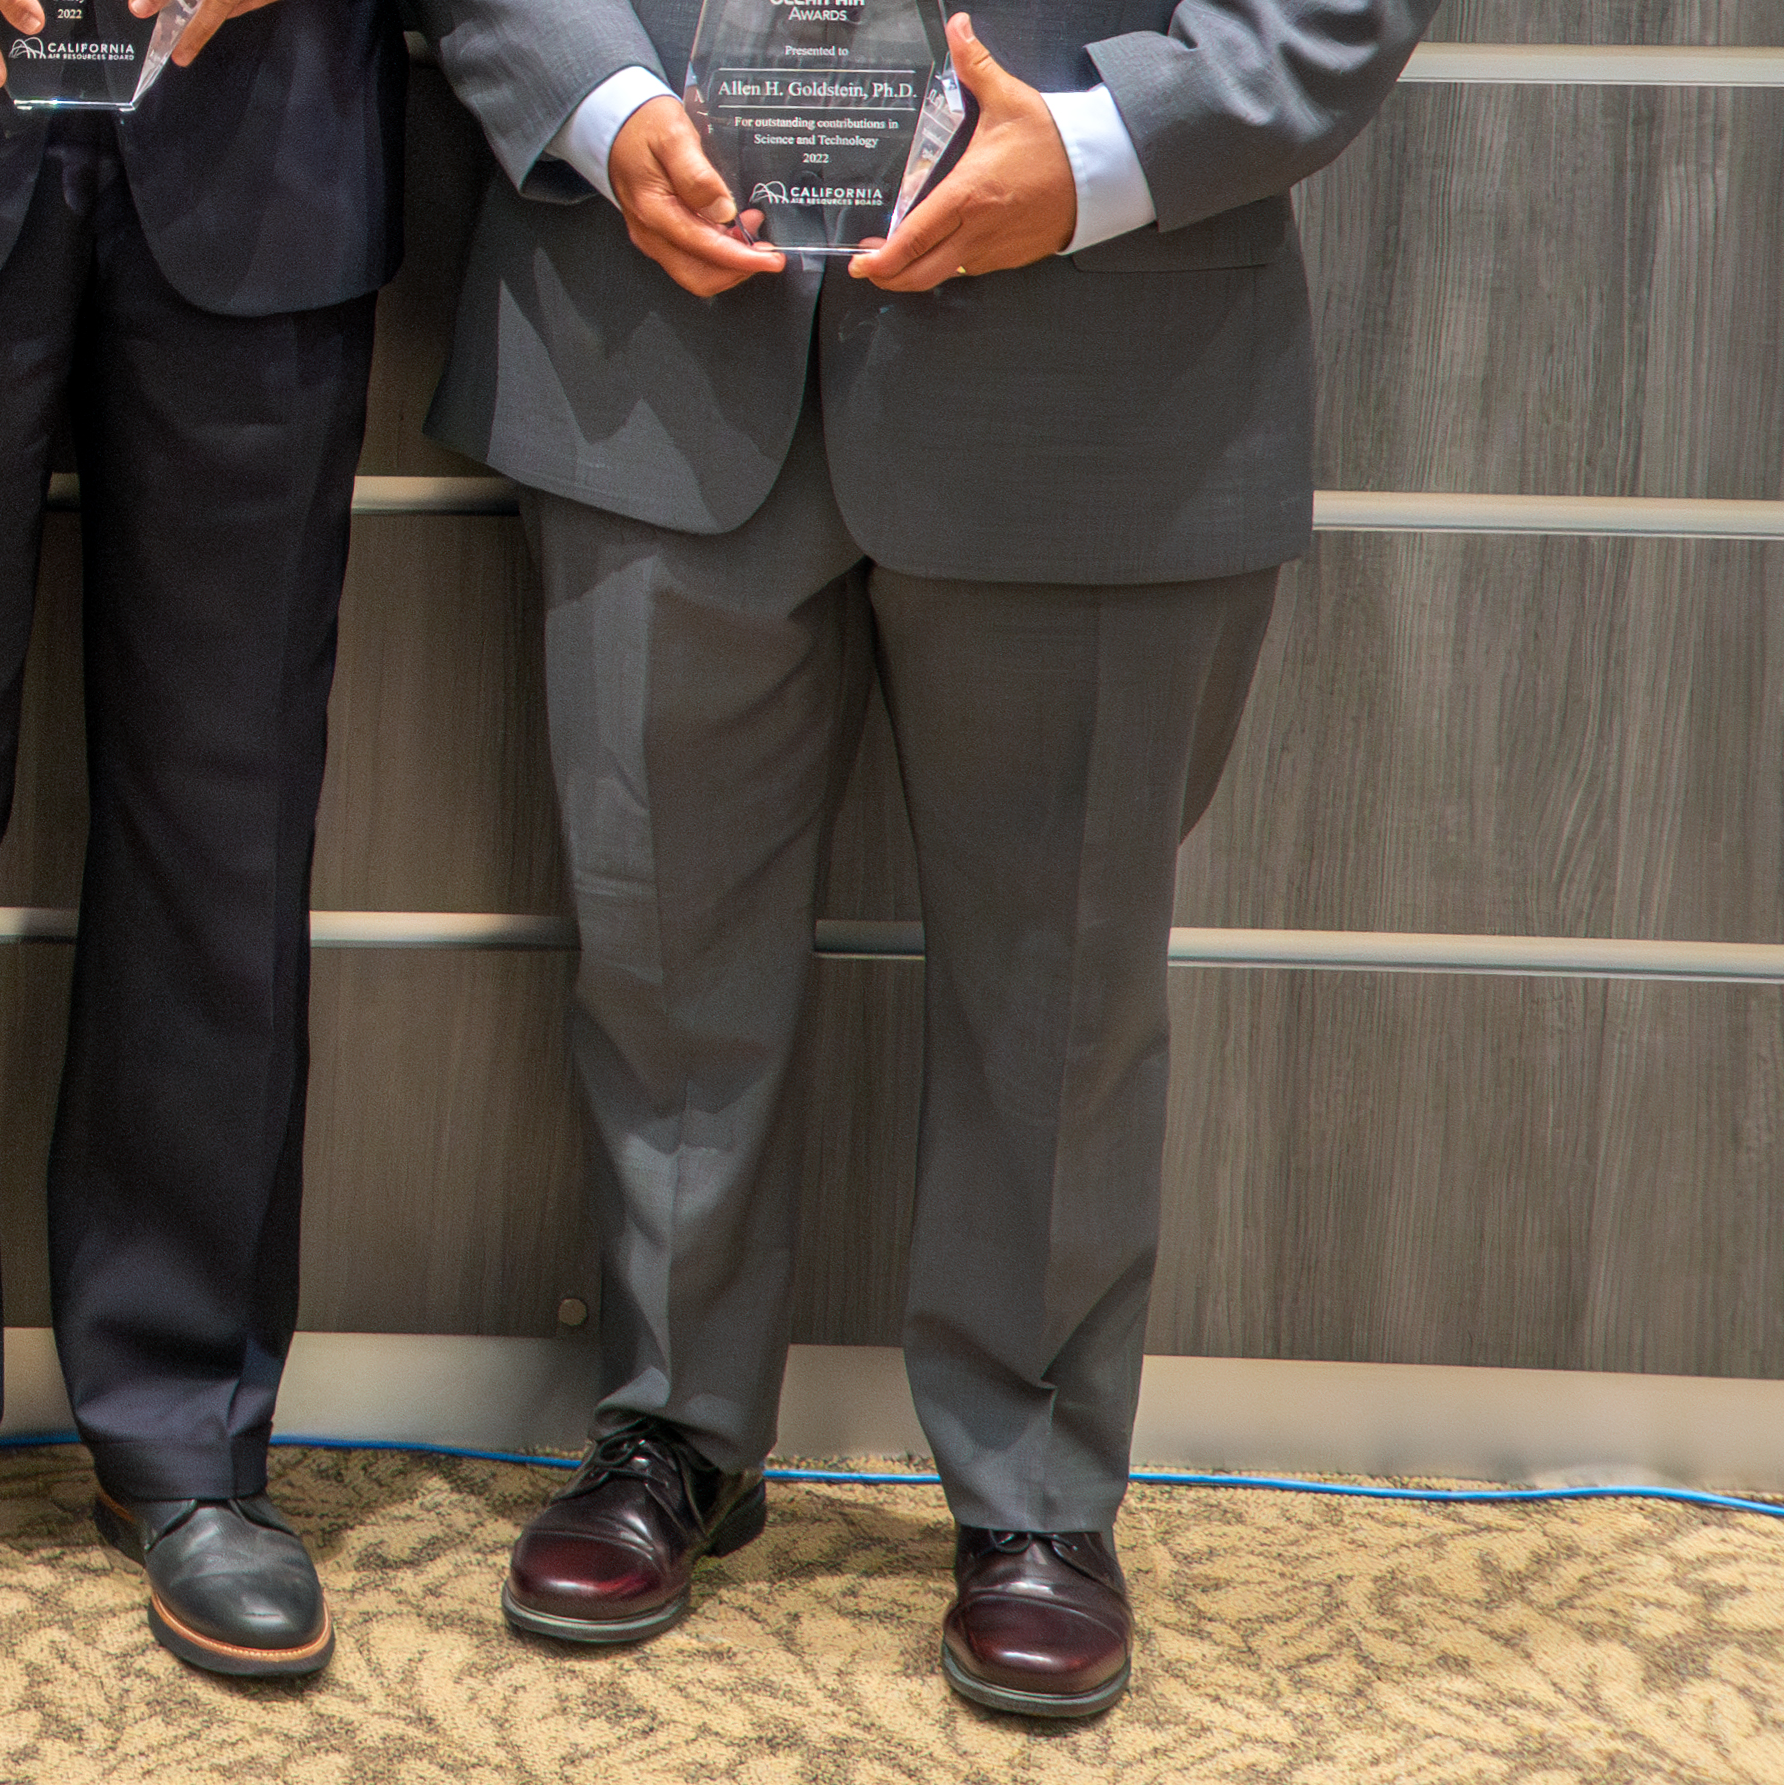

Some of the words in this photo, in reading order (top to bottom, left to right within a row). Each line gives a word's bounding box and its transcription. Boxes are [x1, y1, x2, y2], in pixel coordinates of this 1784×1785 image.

[57, 9, 82, 19] 2022
[47, 42, 134, 53] CALIFORNIA
[785, 45, 835, 56] Presented
[838, 47, 849, 56] to
[718, 80, 761, 96] Allen
[765, 81, 784, 96] H.
[788, 81, 869, 100] Goldstein,
[871, 82, 917, 98] Ph.D.
[735, 116, 752, 127] For
[755, 116, 816, 130] outstanding
[817, 117, 886, 129] contributions
[888, 118, 899, 129] in
[753, 134, 794, 145] Science
[796, 134, 816, 145] and
[818, 134, 879, 149] Technology
[803, 153, 829, 163] 2022
[790, 187, 882, 199] CALIFORNIA
